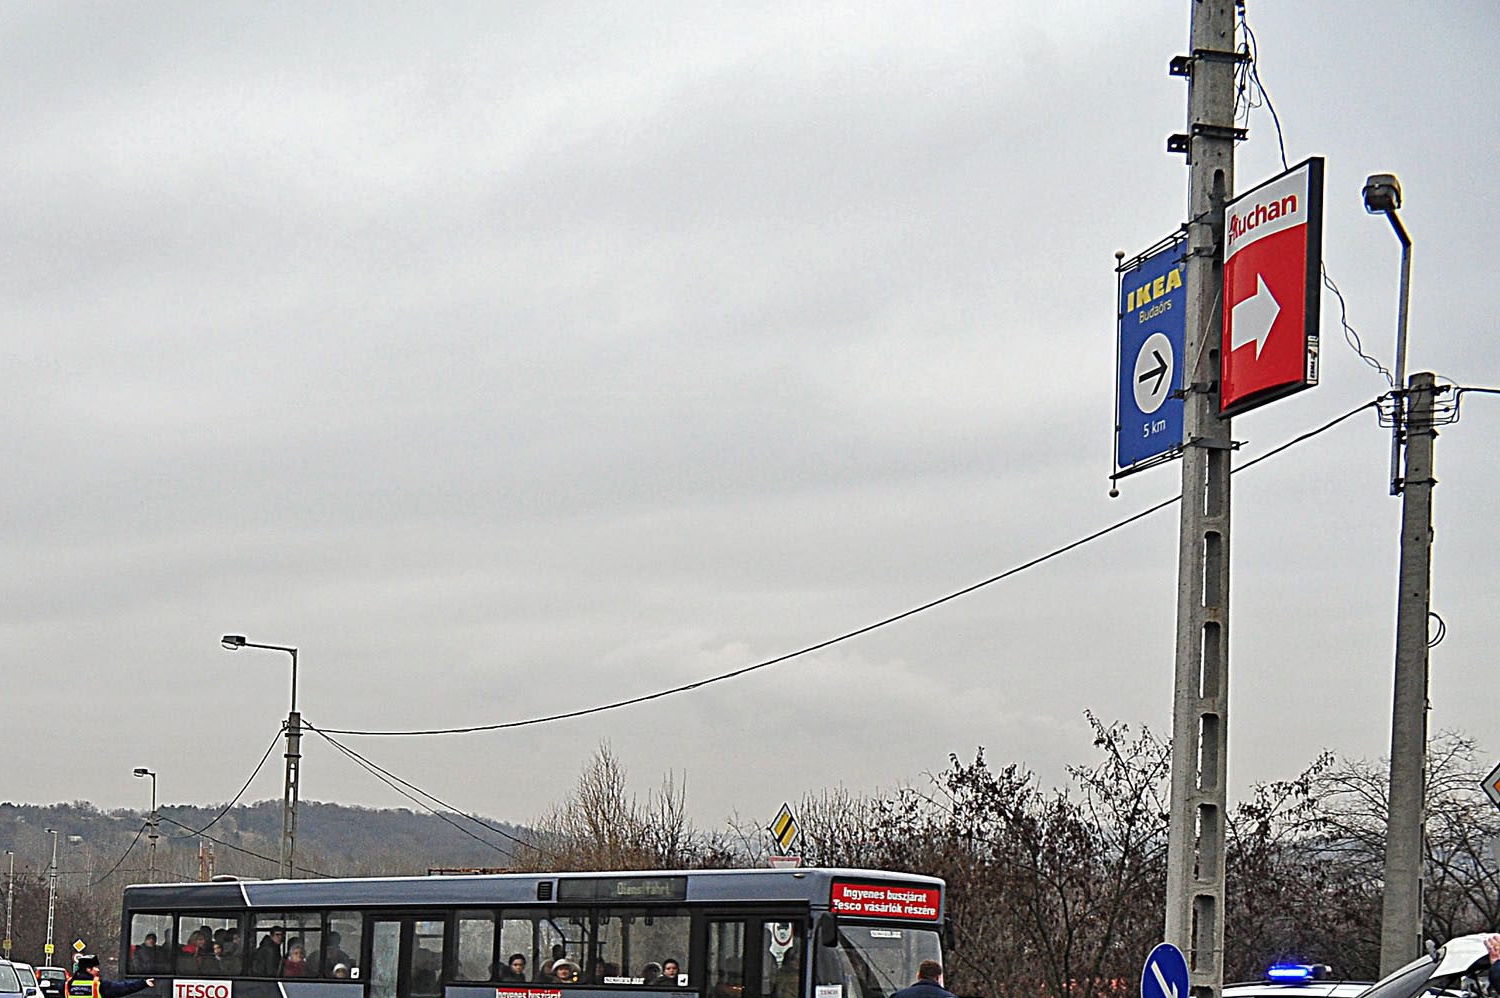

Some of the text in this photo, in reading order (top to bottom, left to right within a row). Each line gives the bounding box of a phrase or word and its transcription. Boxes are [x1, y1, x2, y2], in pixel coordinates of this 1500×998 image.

[1228, 194, 1298, 246] Auchan
[1127, 268, 1182, 313] IKEA
[1143, 420, 1166, 438] 5 km
[843, 887, 927, 904] Ingyenes buszjárat
[833, 899, 937, 916] Tesco vásárlók részére
